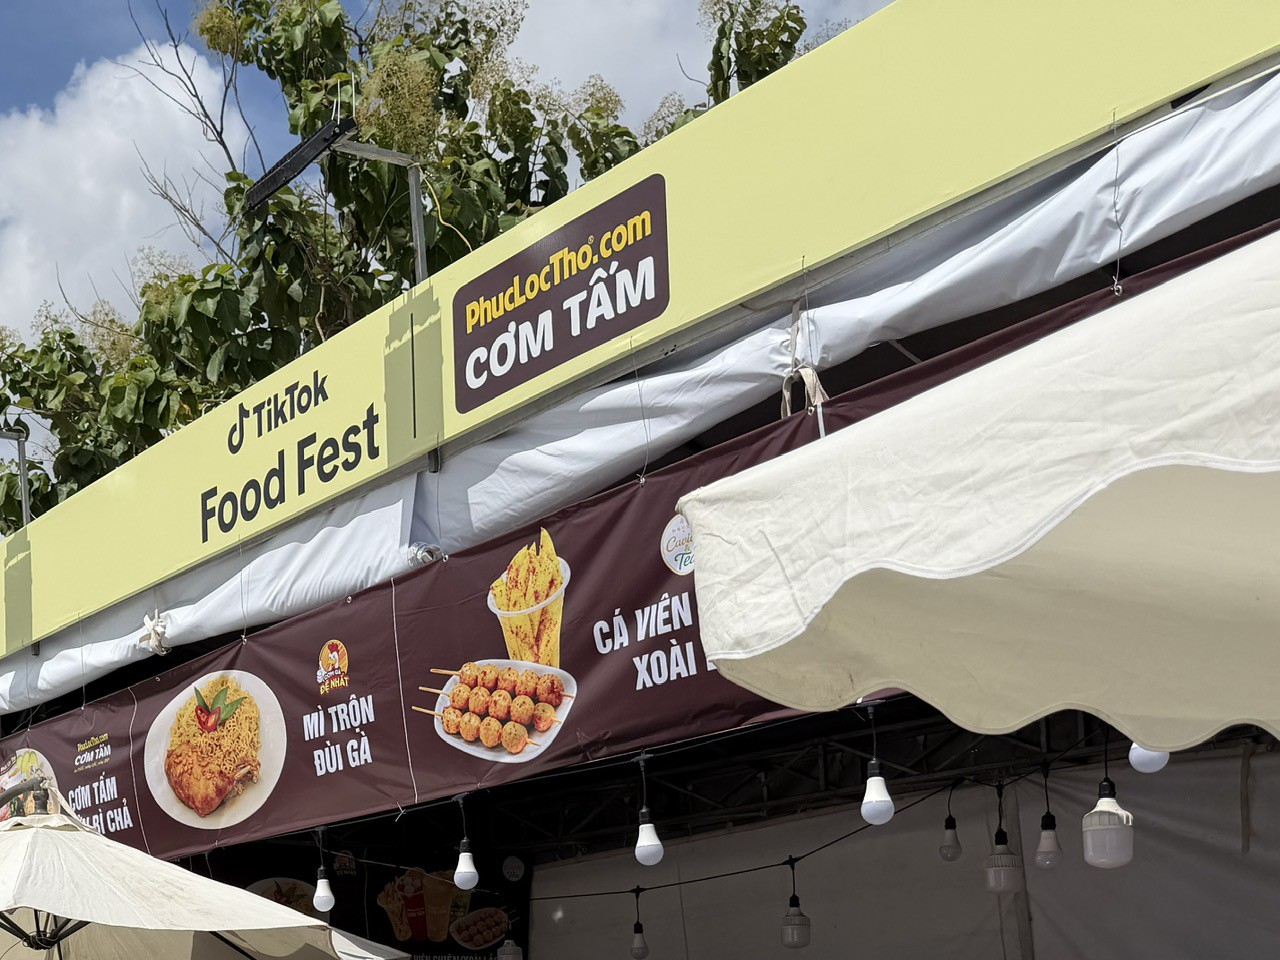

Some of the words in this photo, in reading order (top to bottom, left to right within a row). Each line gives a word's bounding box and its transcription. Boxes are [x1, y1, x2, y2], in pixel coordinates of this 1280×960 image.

[465, 309, 554, 390] CƠM
[562, 256, 656, 338] TẤM
[252, 369, 329, 439] TikTok
[200, 448, 286, 544] Food
[296, 401, 380, 497] Fest
[592, 608, 629, 655] CÁ
[635, 591, 693, 643] VIÊN
[632, 640, 698, 691] XOÀI
[302, 704, 326, 742] MÌ
[327, 693, 376, 733] TRỘN
[313, 740, 344, 777] ĐÙI
[346, 730, 373, 769] GÀ
[68, 785, 92, 813] CƠM
[92, 771, 119, 806] TẤM
[106, 797, 134, 833] CHẢ
